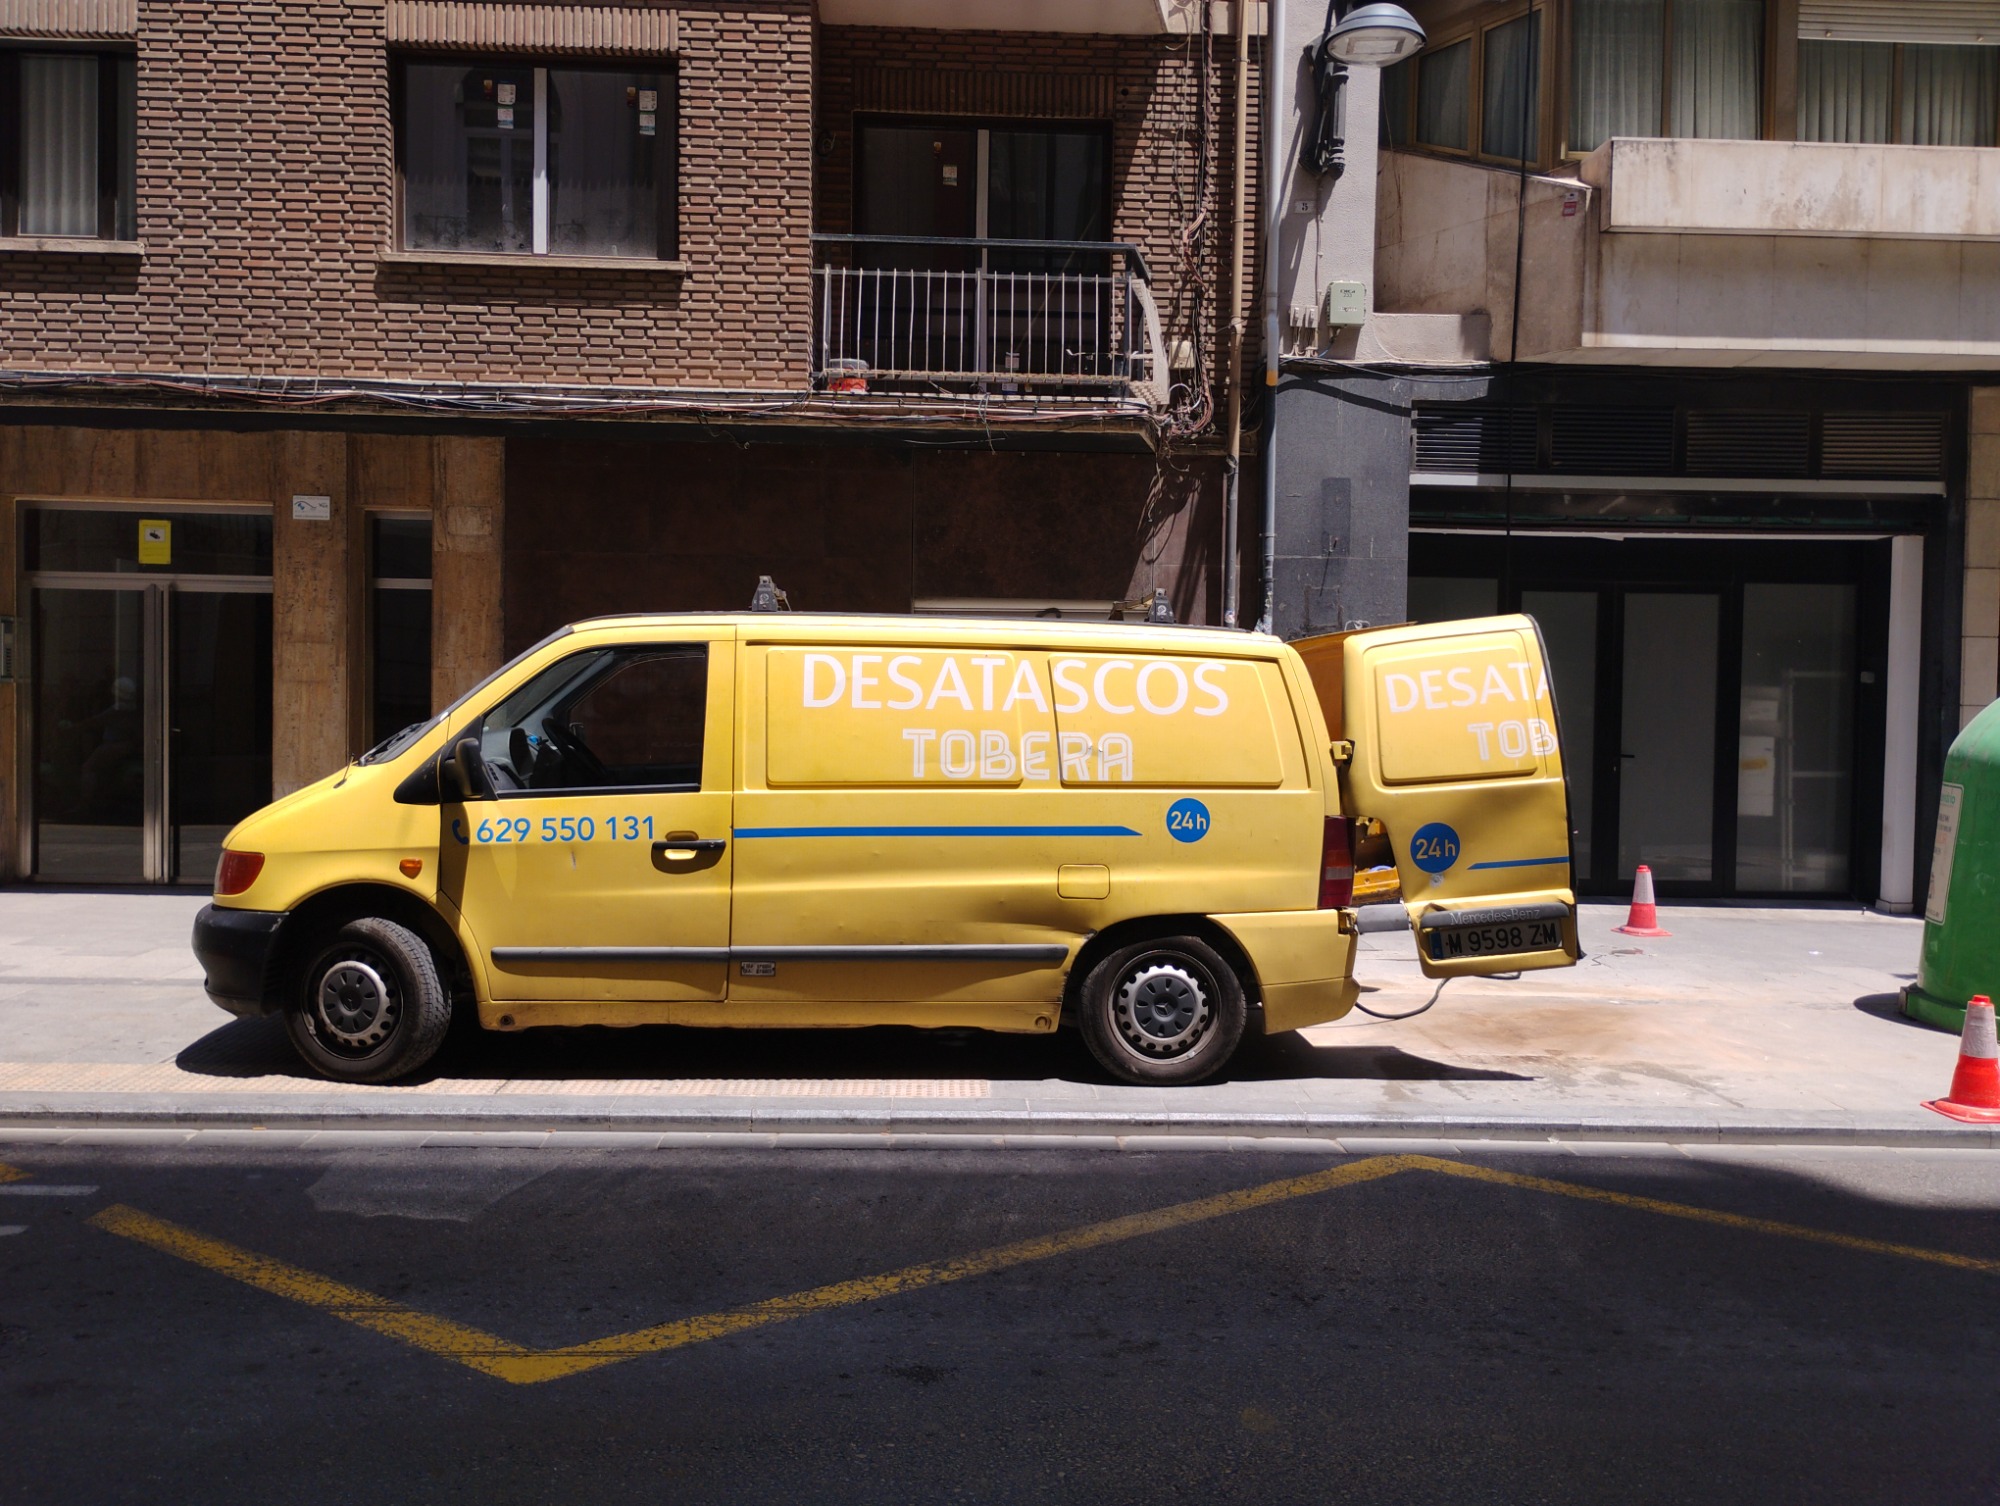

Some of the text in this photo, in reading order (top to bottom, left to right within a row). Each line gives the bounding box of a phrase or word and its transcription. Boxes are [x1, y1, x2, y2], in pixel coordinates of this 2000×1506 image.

[803, 654, 1229, 716] DESATASCOS
[902, 728, 1133, 782] TOBERA
[1467, 718, 1557, 761] TOB
[476, 815, 654, 843] 629 550 131
[1450, 908, 1540, 925] Mercedes-Benz
[1468, 926, 1523, 951] 9598
